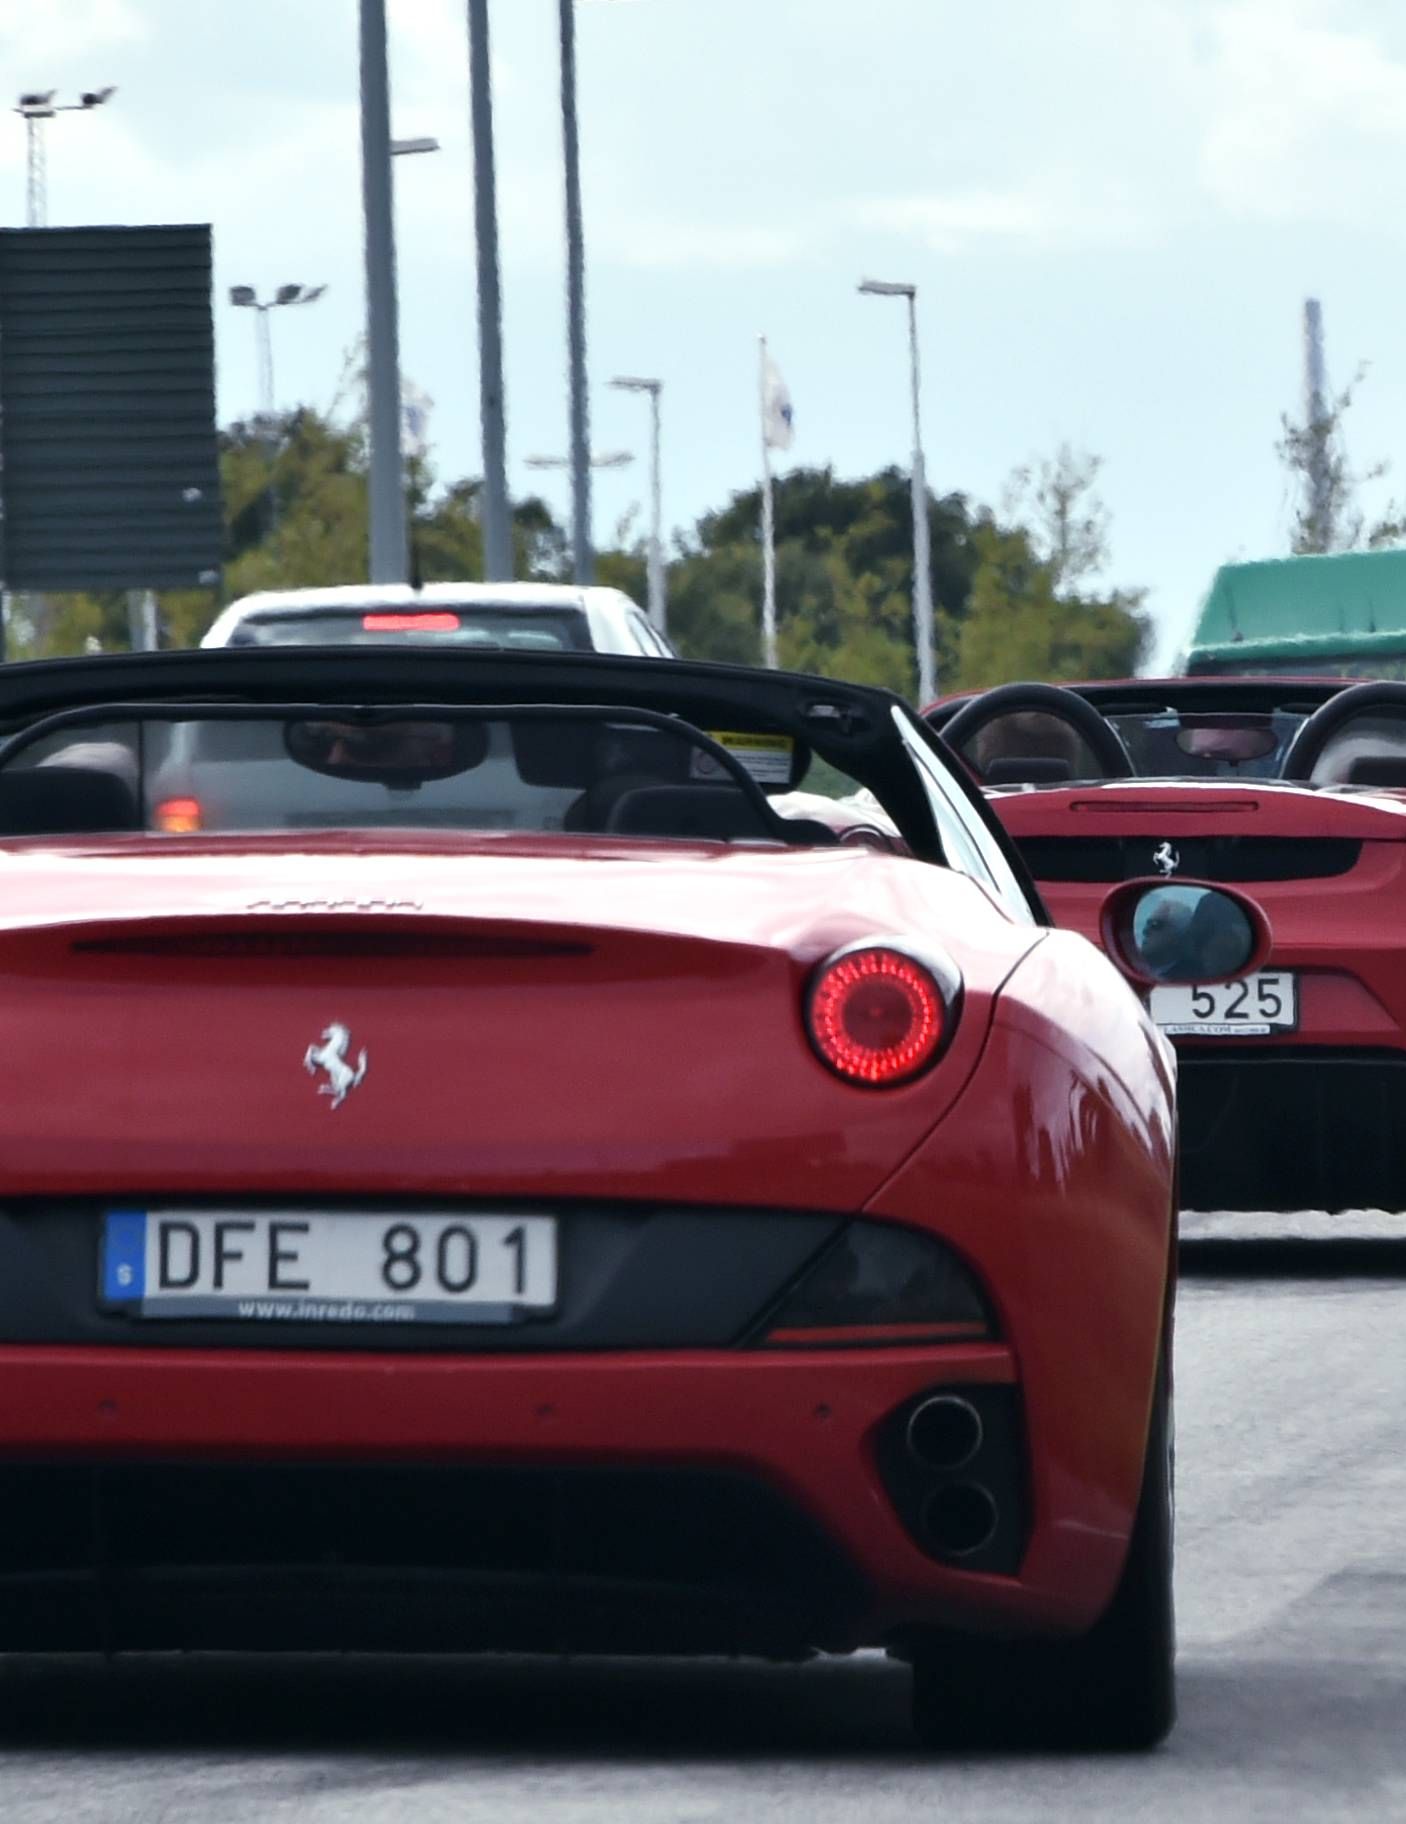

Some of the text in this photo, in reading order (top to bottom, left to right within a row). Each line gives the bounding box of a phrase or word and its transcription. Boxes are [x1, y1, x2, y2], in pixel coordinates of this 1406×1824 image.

[1191, 978, 1283, 1020] 525
[158, 1221, 527, 1297] DFE 801
